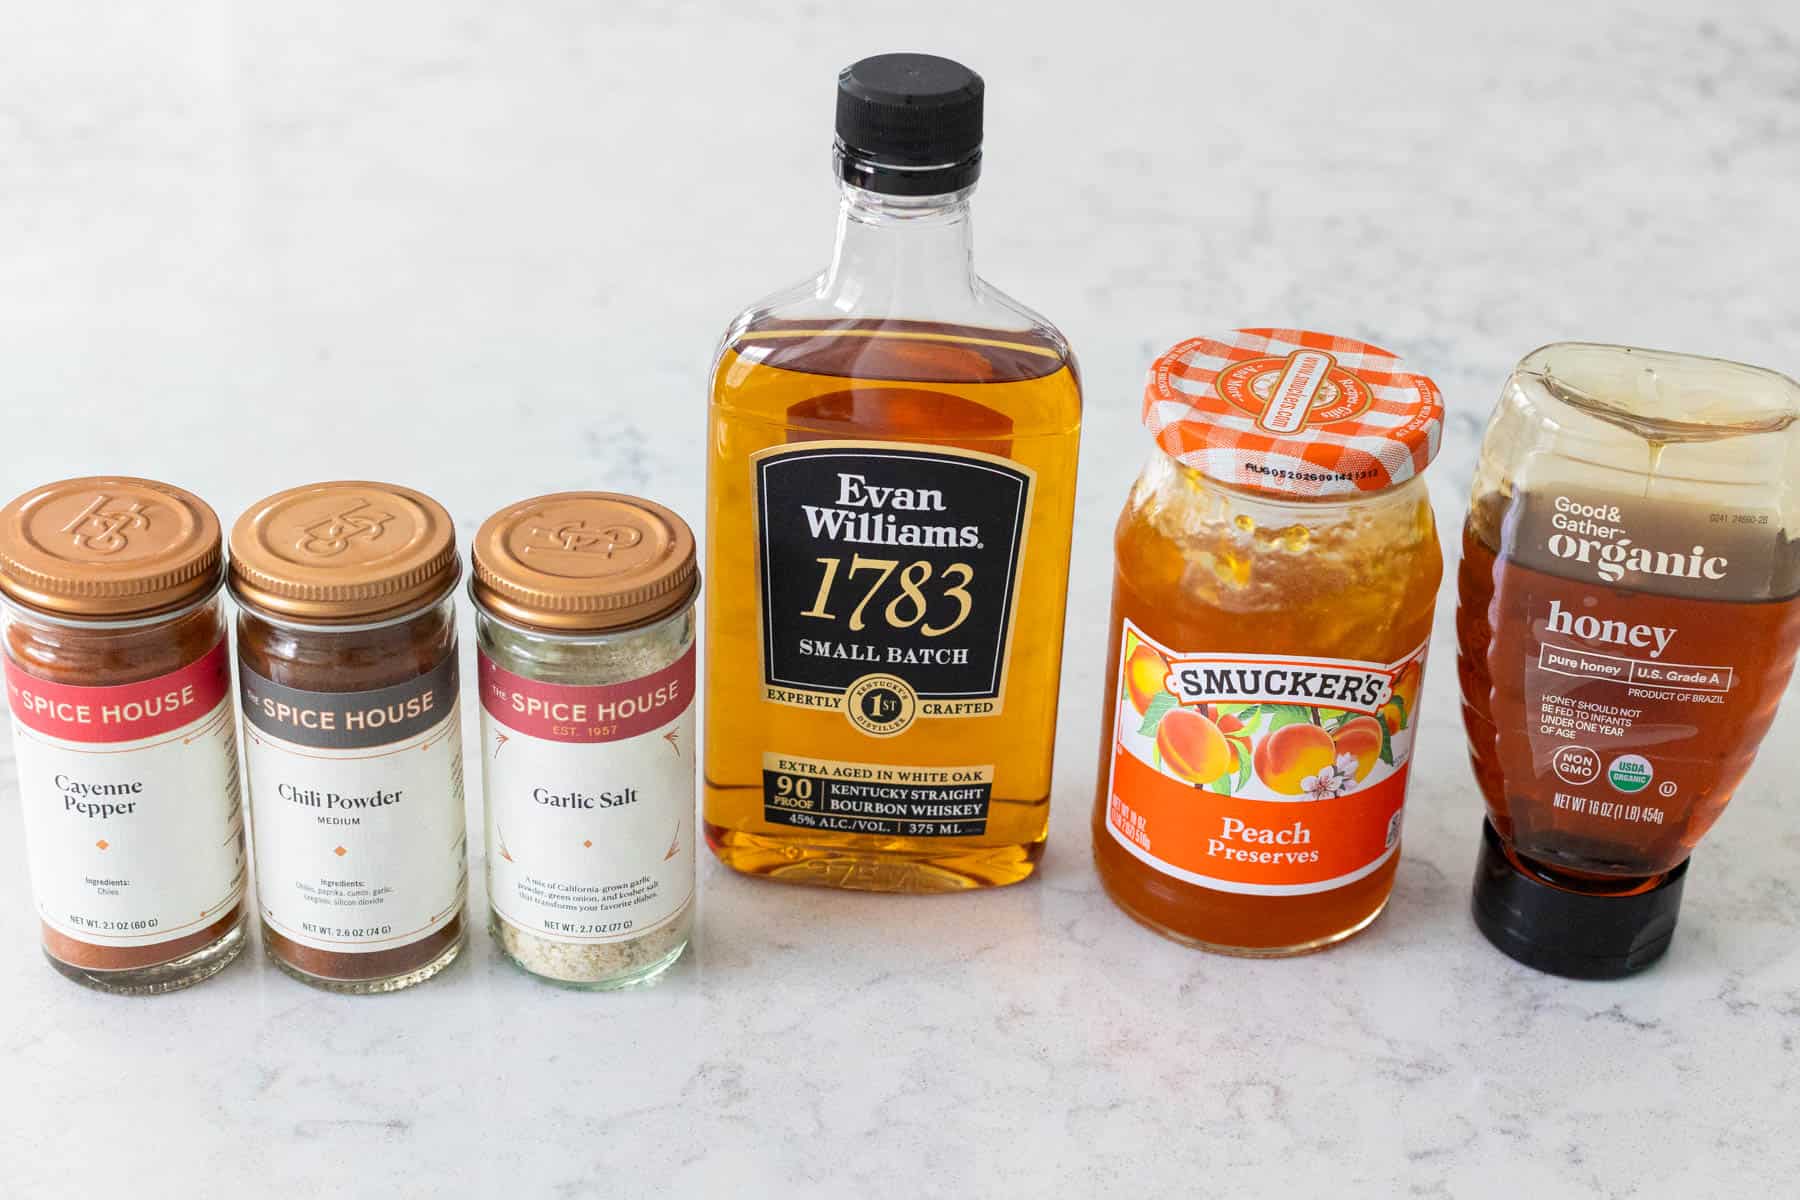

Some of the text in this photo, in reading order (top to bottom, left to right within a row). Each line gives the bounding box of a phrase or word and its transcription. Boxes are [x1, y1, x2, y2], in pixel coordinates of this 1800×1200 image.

[835, 473, 946, 511] Evan
[1554, 496, 1621, 523] Good&
[1548, 534, 1728, 582] organic
[800, 552, 975, 637] 1783
[1545, 600, 1678, 658] honey
[799, 638, 969, 665] SMALL BATCH
[1548, 654, 1621, 676] pure honey
[1637, 668, 1720, 684] U.S. Grade A
[1180, 669, 1385, 706] SMUCKER'S
[1628, 688, 1725, 704] PRODUCT OF BRAZIL
[22, 684, 194, 724] SPICE HOUSE
[263, 690, 434, 730] SPICE HOUSE
[511, 693, 587, 722] SPICE
[598, 680, 679, 721] HOUSE
[768, 689, 994, 714] EXPERTLY CRAFTED
[1542, 695, 1642, 718] HONEY SHOULD NOT
[1541, 703, 1632, 727] BE FED TO INFANTS
[1541, 713, 1624, 736] UNDER ONE YEAR
[552, 725, 618, 736] EST. 1957
[1540, 725, 1577, 739] OF AGE
[779, 760, 983, 782] EXTRA AGED IN WHITE OAK
[1560, 763, 1592, 776] GMO
[1563, 753, 1593, 766] NON
[1619, 761, 1644, 773] USDA
[55, 774, 143, 798] Cayenne
[278, 783, 403, 809] Chili Powder
[777, 775, 812, 799] 90
[831, 784, 984, 800] KENTUCKY STRAIGHT
[64, 795, 136, 819] Pepper
[533, 788, 639, 809] Garlic Salt
[773, 796, 815, 809] PROOF
[830, 800, 983, 817] BOURBON WHISKEY
[1553, 792, 1571, 808] NET
[1572, 796, 1587, 812] WT
[1589, 800, 1599, 815] 16
[1600, 802, 1614, 817] OZ
[1642, 807, 1664, 824] 454g
[317, 816, 360, 825] MEDIUM
[790, 813, 815, 826] 45%
[909, 823, 933, 834] 375
[939, 824, 962, 834] ML
[1220, 816, 1311, 845] Peach
[1207, 838, 1319, 864] Preserves
[117, 921, 129, 930] OZ
[302, 921, 317, 932] NET
[352, 928, 365, 937] OZ
[366, 927, 379, 937] (74
[544, 919, 560, 930] NET
[562, 922, 578, 933] WT.
[595, 923, 607, 933] OZ
